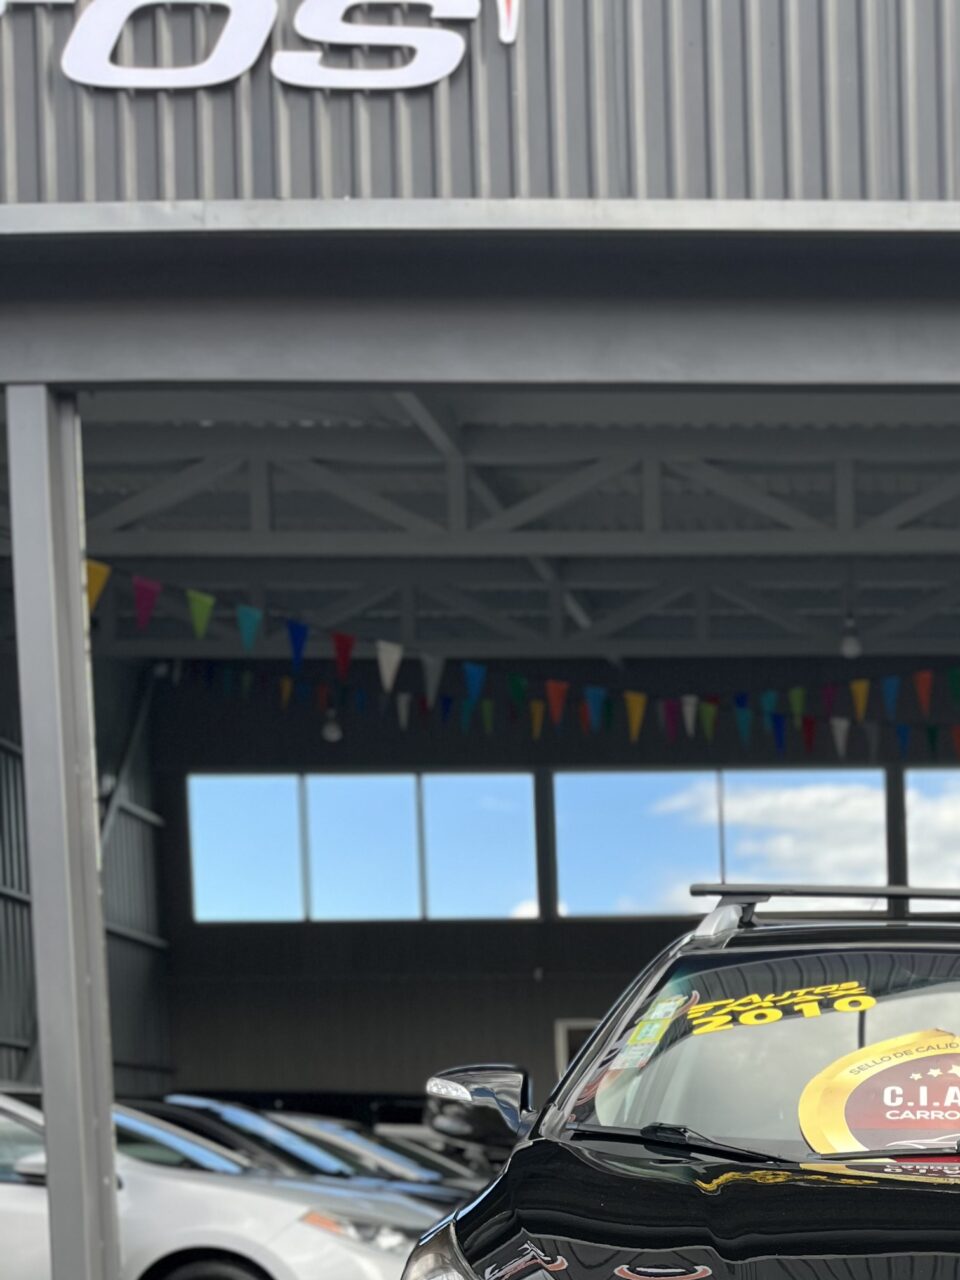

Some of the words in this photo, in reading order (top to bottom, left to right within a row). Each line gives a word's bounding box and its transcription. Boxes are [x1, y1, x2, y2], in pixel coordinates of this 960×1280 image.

[0, 0, 482, 91] OS
[691, 995, 878, 1036] 2010
[848, 1055, 892, 1076] SELLO
[892, 1049, 914, 1059] DE
